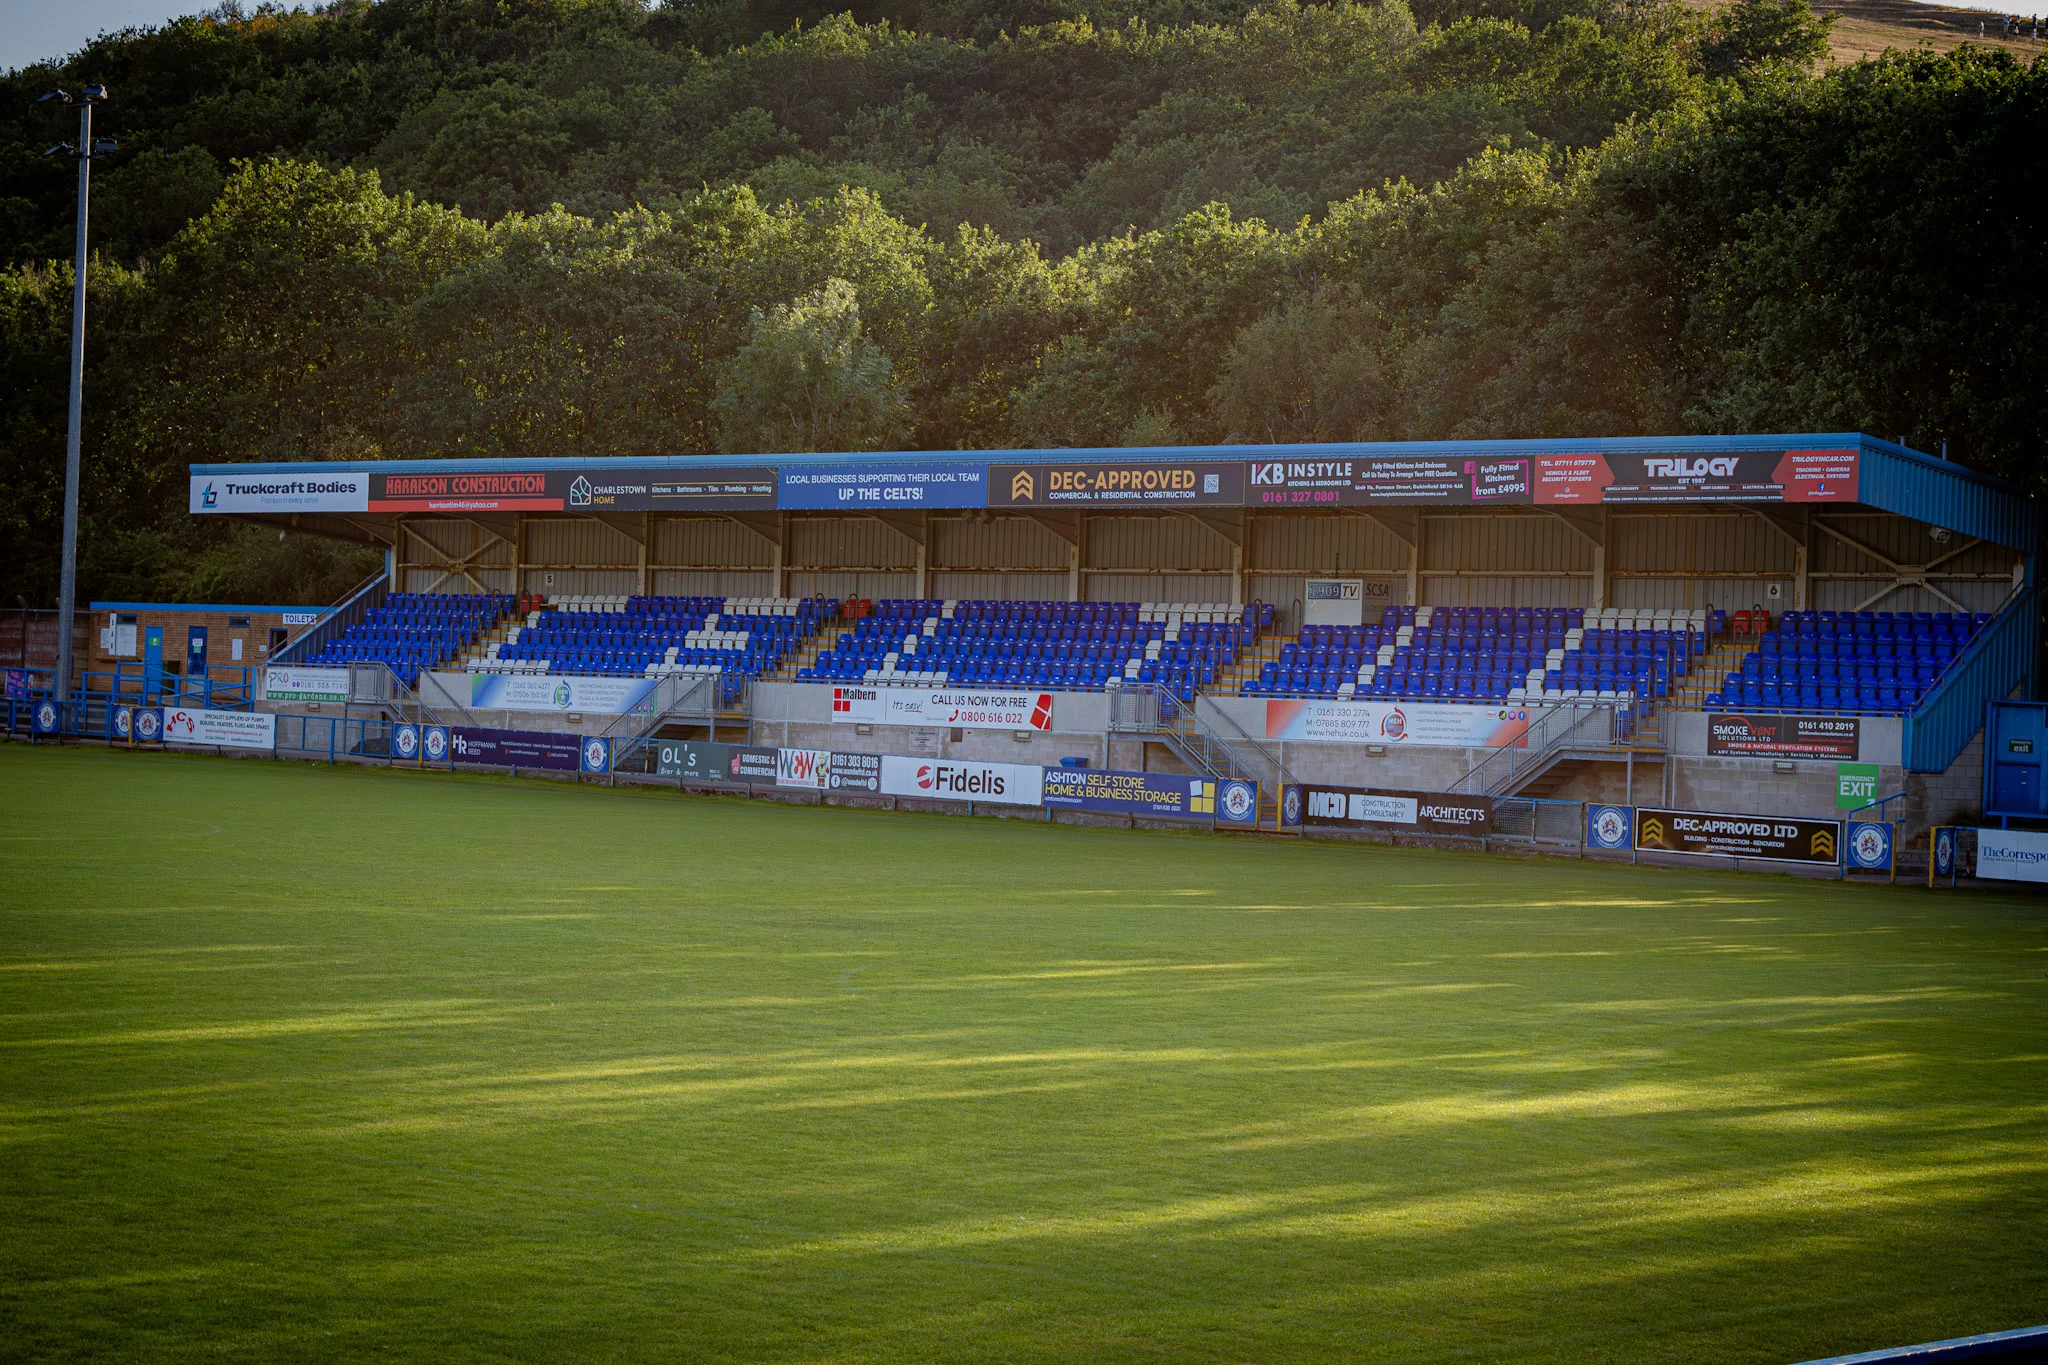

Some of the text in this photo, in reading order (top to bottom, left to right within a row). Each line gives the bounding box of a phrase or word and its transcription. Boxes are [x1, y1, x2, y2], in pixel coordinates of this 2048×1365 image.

[1288, 463, 1352, 478] INSTYLE
[1481, 463, 1519, 475] Fully Fitted
[1643, 457, 1739, 477] TRILOGY
[786, 472, 980, 484] LOCAL BUSINESSES SUPPORTING THEIR LOCAL TEAM
[1049, 470, 1196, 490] DEC-APPROVED
[1485, 474, 1515, 483] Kitchens
[226, 481, 357, 495] Truckcraft Bodies
[386, 476, 545, 495] HARRISON CONSTRUCTION
[594, 485, 647, 494] CHARLESTOWN
[1475, 483, 1525, 497] from £4995
[838, 487, 923, 500] UP THE CELTS!
[1049, 492, 1092, 500] COMMERCIAL
[1102, 491, 1141, 499] RESIDENTIAL
[1144, 491, 1196, 499] CONSTRUCTION
[1262, 490, 1340, 503] 0161 327 0801
[594, 495, 615, 505] HOME
[547, 575, 553, 584] 5
[1310, 584, 1359, 598] 1909 TV
[1770, 585, 1778, 595] 6
[284, 614, 316, 624] TOILETS
[842, 688, 877, 701] Malbern
[931, 694, 1028, 708] CALL US NOW FOR FREE
[961, 711, 1023, 724] 0800 616 022
[1316, 708, 1370, 717] 0161 330 2774
[1315, 720, 1370, 729] 07885 809 777
[1712, 725, 1777, 736] SMOKE VENT
[1798, 721, 1855, 731] 0161 410 2019
[1306, 729, 1370, 739] www.hehuk.co.uk
[468, 741, 497, 749] HOFFMANN
[2013, 744, 2029, 753] exit
[468, 748, 482, 756] REED
[742, 754, 776, 765] DOMESTIC &
[832, 753, 879, 769] 0161 303 8016
[740, 765, 777, 777] COMMERCIAL
[935, 766, 1006, 796] Fidelis
[1045, 771, 1145, 789] ASHTON SELF STORE
[1840, 775, 1876, 783] EMERGENCY
[1045, 784, 1182, 804] HOME & BUSINESS STORAGE
[1840, 781, 1875, 797] EXIT
[1307, 790, 1347, 819] MCD
[1360, 799, 1406, 809] CONSTRUCTION
[1363, 809, 1405, 819] CONSULTANCY
[1419, 805, 1486, 821] ARCHITECTS
[1673, 817, 1799, 839] DEC-APPROVED LTD
[1683, 835, 1785, 848] BUILDING CONSTRUCTION RENOVATION
